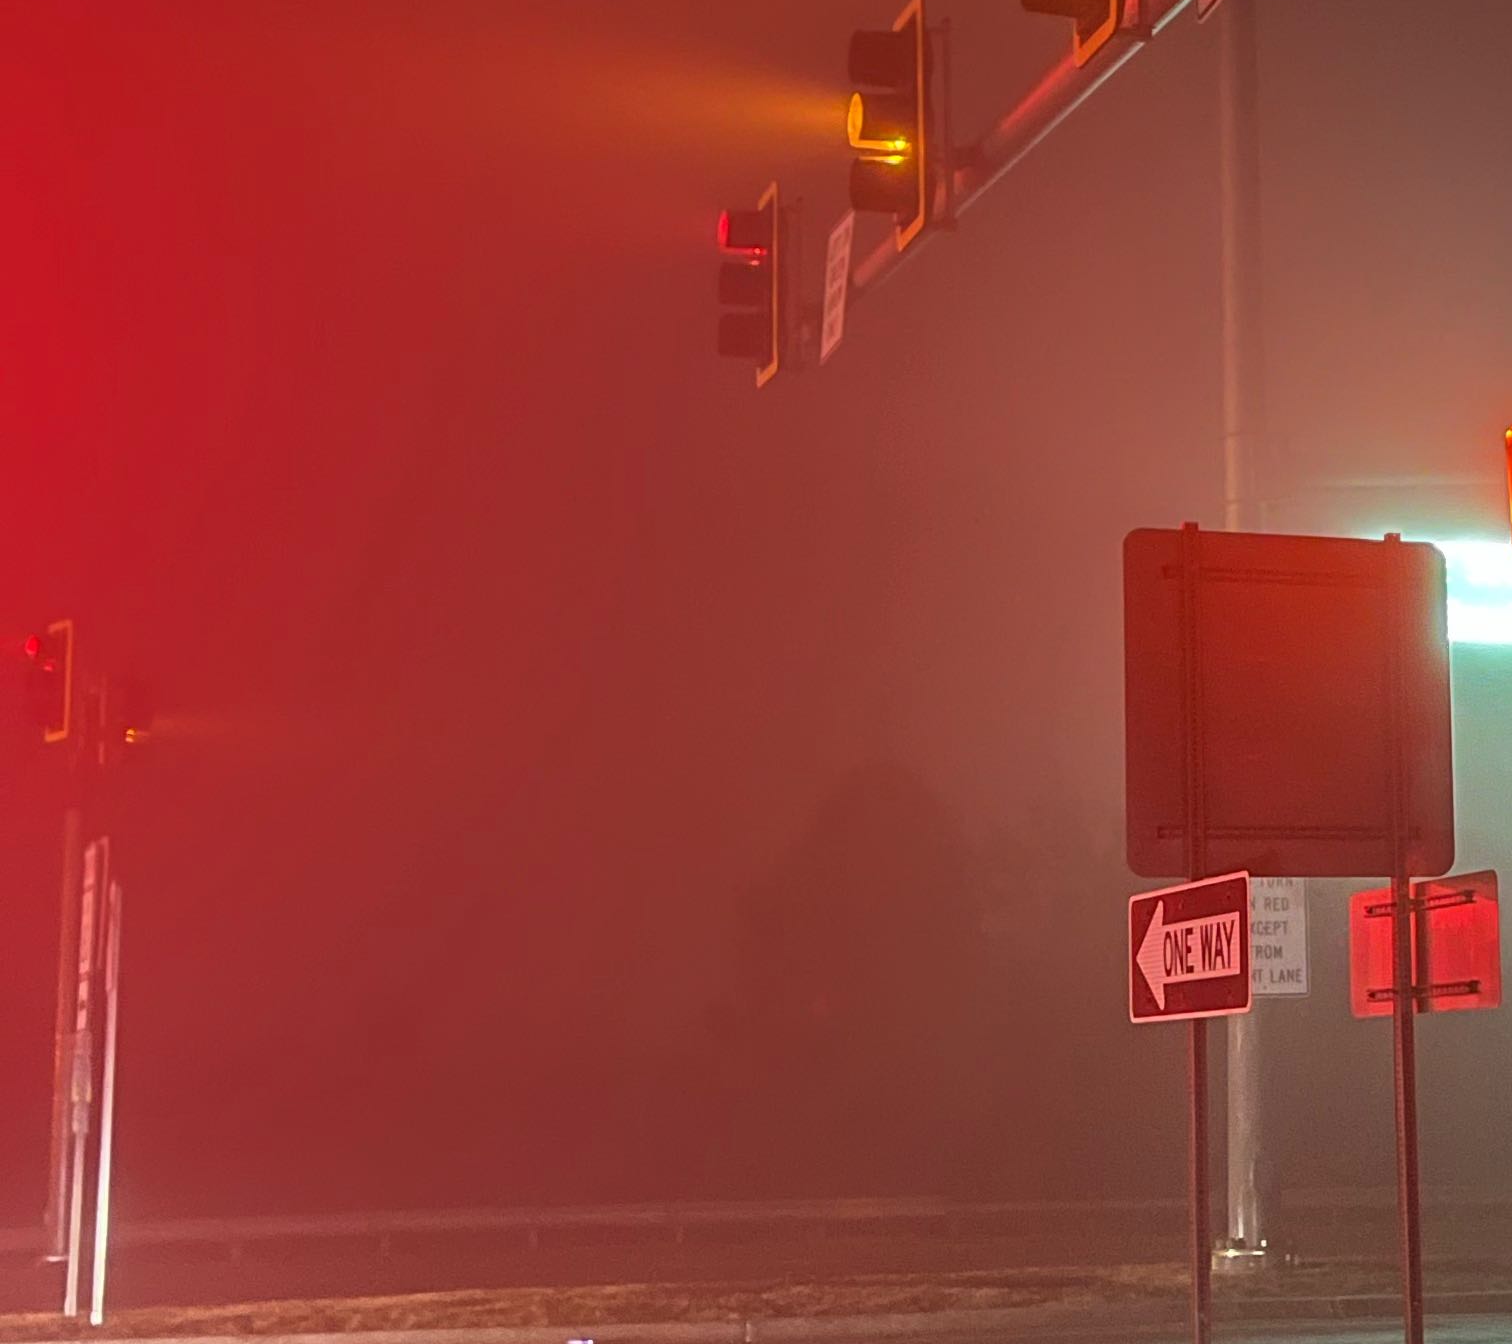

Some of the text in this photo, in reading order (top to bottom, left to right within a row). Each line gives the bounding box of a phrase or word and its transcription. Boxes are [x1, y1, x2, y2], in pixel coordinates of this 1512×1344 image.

[1264, 897, 1289, 911] RED
[1163, 920, 1235, 977] ONE WAY
[1270, 969, 1302, 984] LANE
